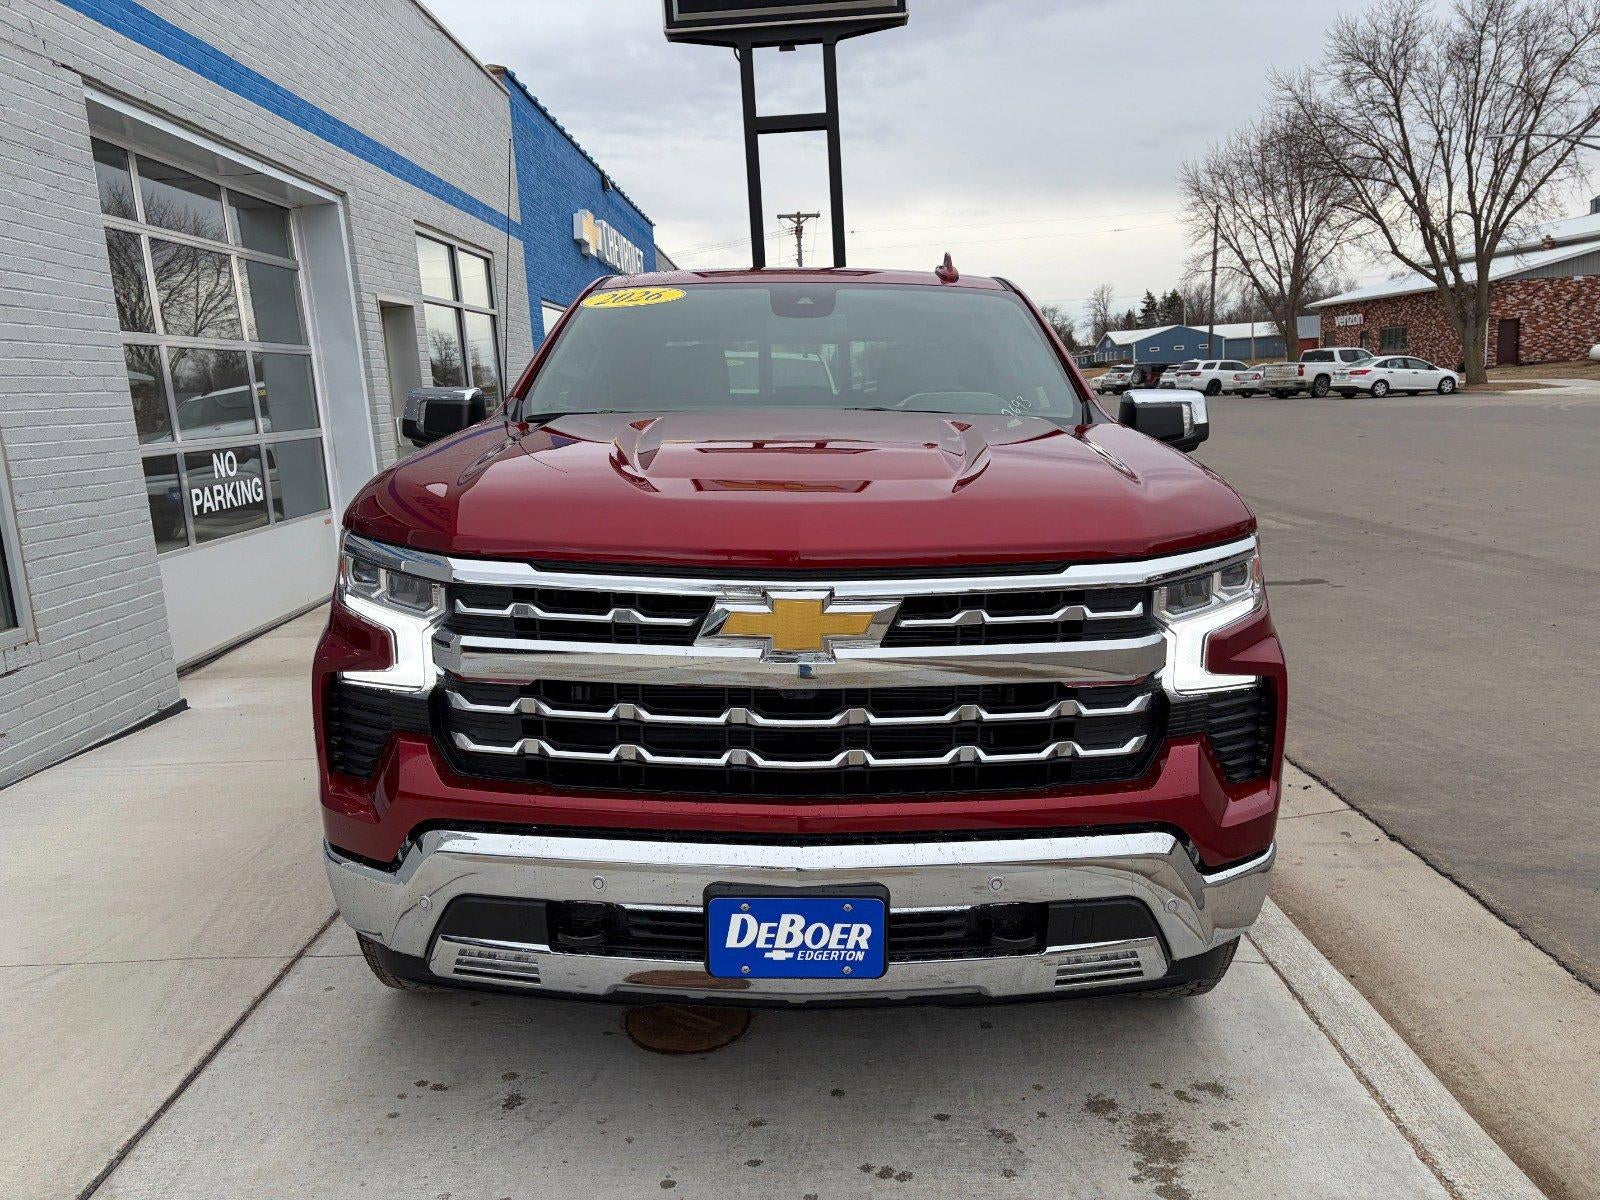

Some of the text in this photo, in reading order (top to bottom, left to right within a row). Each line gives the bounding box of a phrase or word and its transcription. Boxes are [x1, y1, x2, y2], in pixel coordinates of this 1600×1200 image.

[593, 290, 663, 306] 2026
[1334, 313, 1364, 327] verizon
[212, 450, 238, 479] NO
[190, 477, 264, 516] PARKING
[796, 950, 866, 962] EDGERTON
